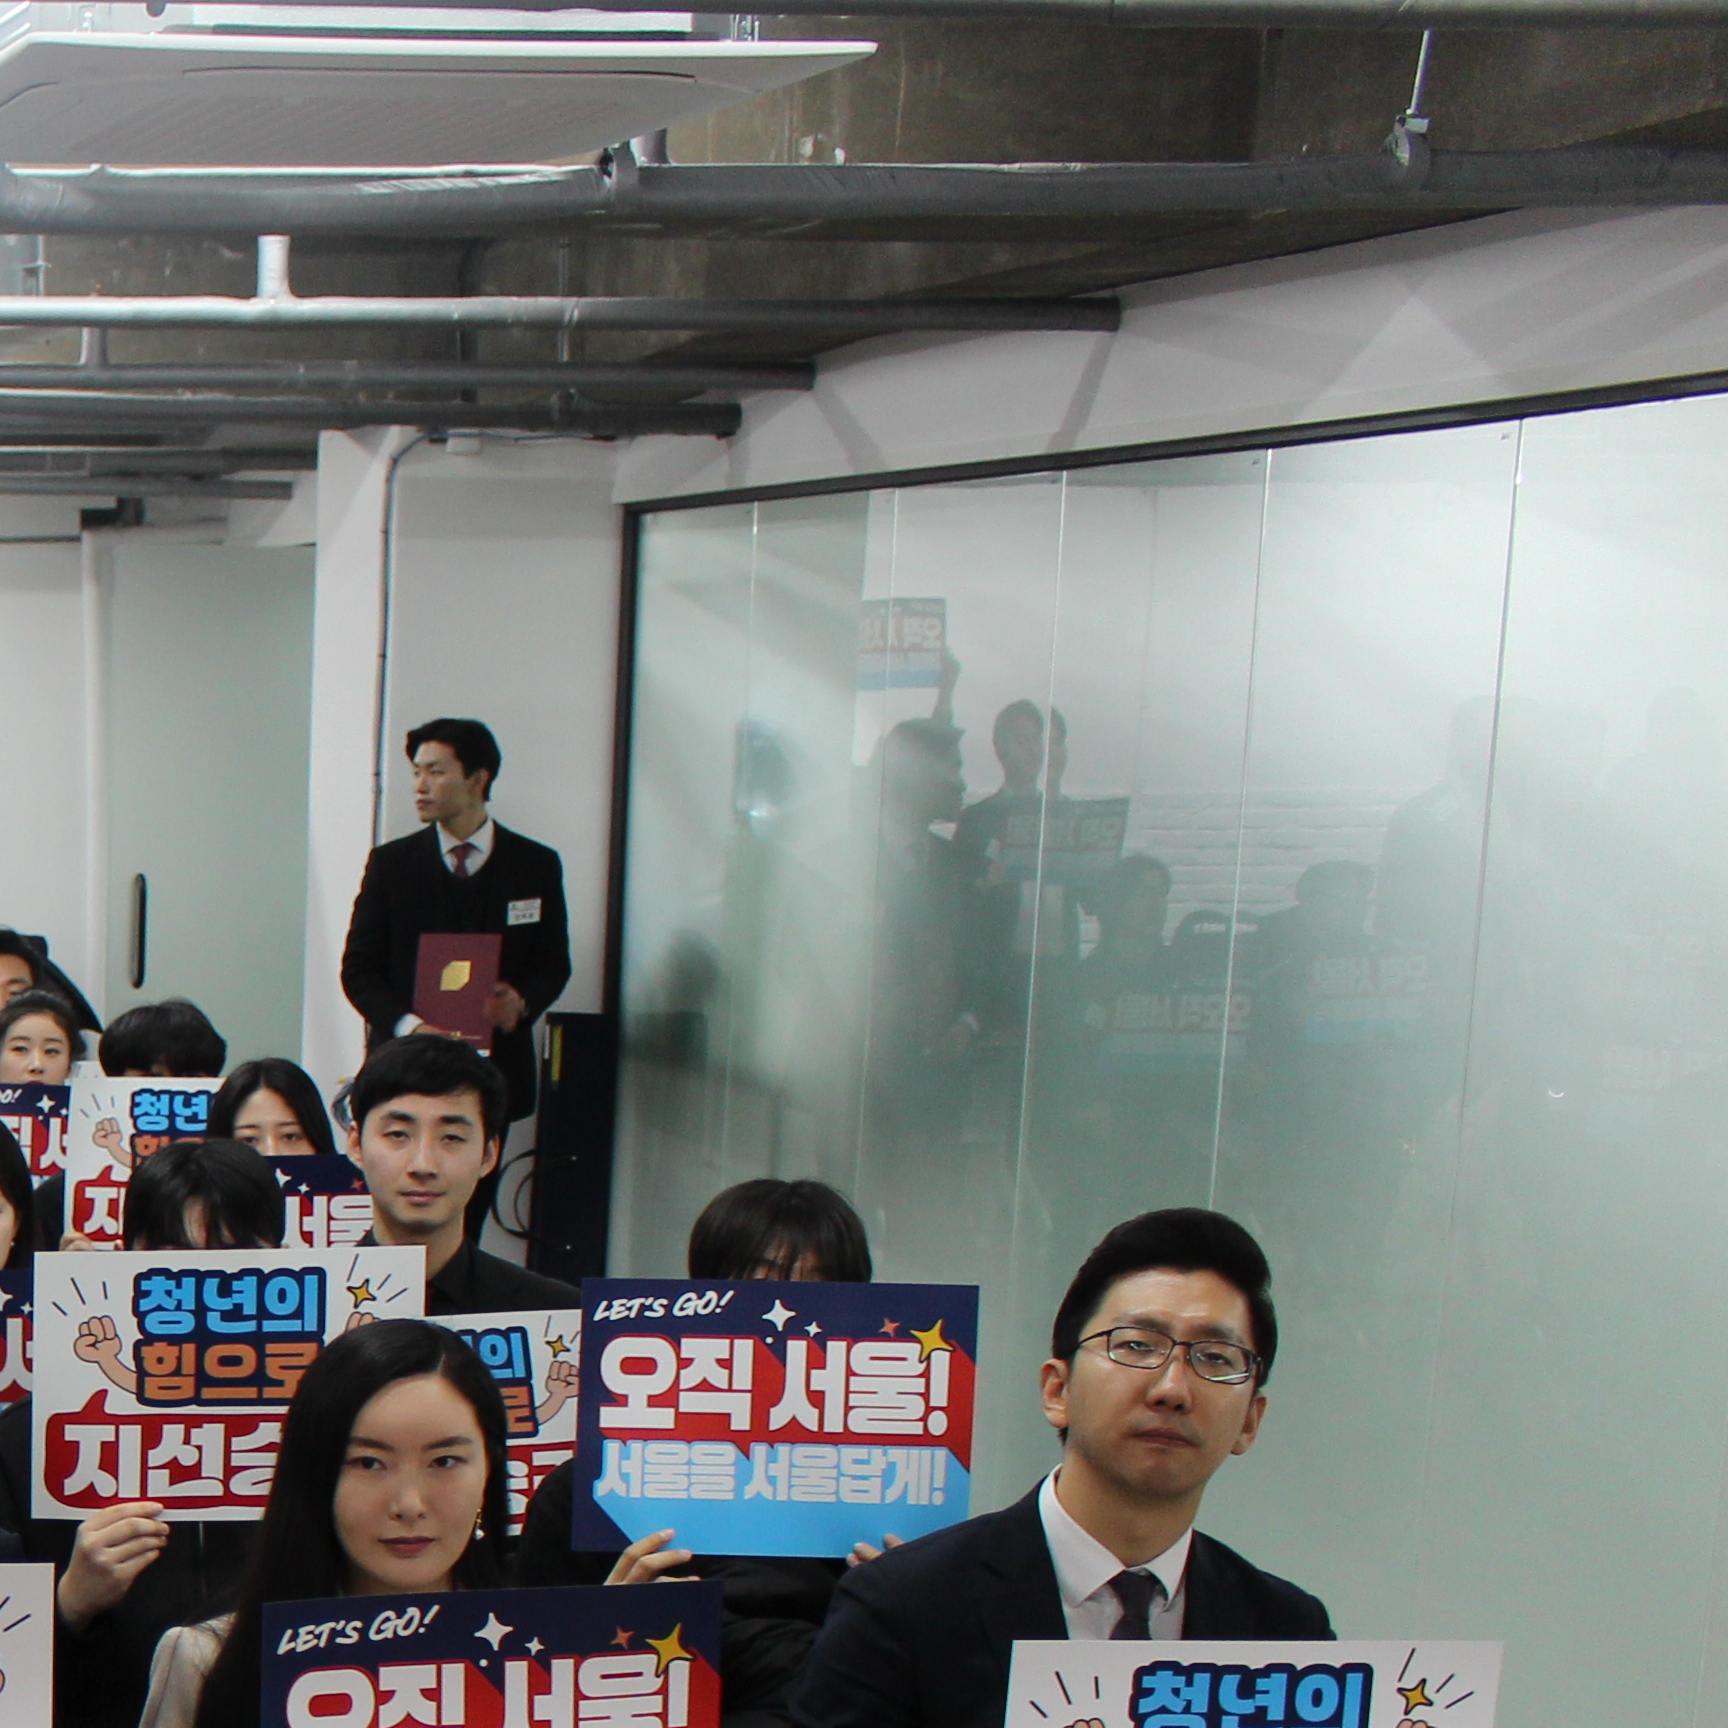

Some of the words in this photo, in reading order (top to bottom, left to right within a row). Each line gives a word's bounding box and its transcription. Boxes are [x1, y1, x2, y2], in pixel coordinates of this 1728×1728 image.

[139, 1274, 319, 1335] 청년의
[593, 1297, 669, 1322] LET'S
[671, 1289, 734, 1318] GO!
[141, 1342, 320, 1400] 힘으로
[599, 1336, 755, 1431] 오직
[769, 1339, 951, 1437] 서울!
[63, 1422, 281, 1500] 지선승
[597, 1440, 737, 1501] 서울을
[744, 1442, 946, 1506] 서울답게!
[275, 1619, 363, 1657] LET'S
[368, 1604, 441, 1642] GO!
